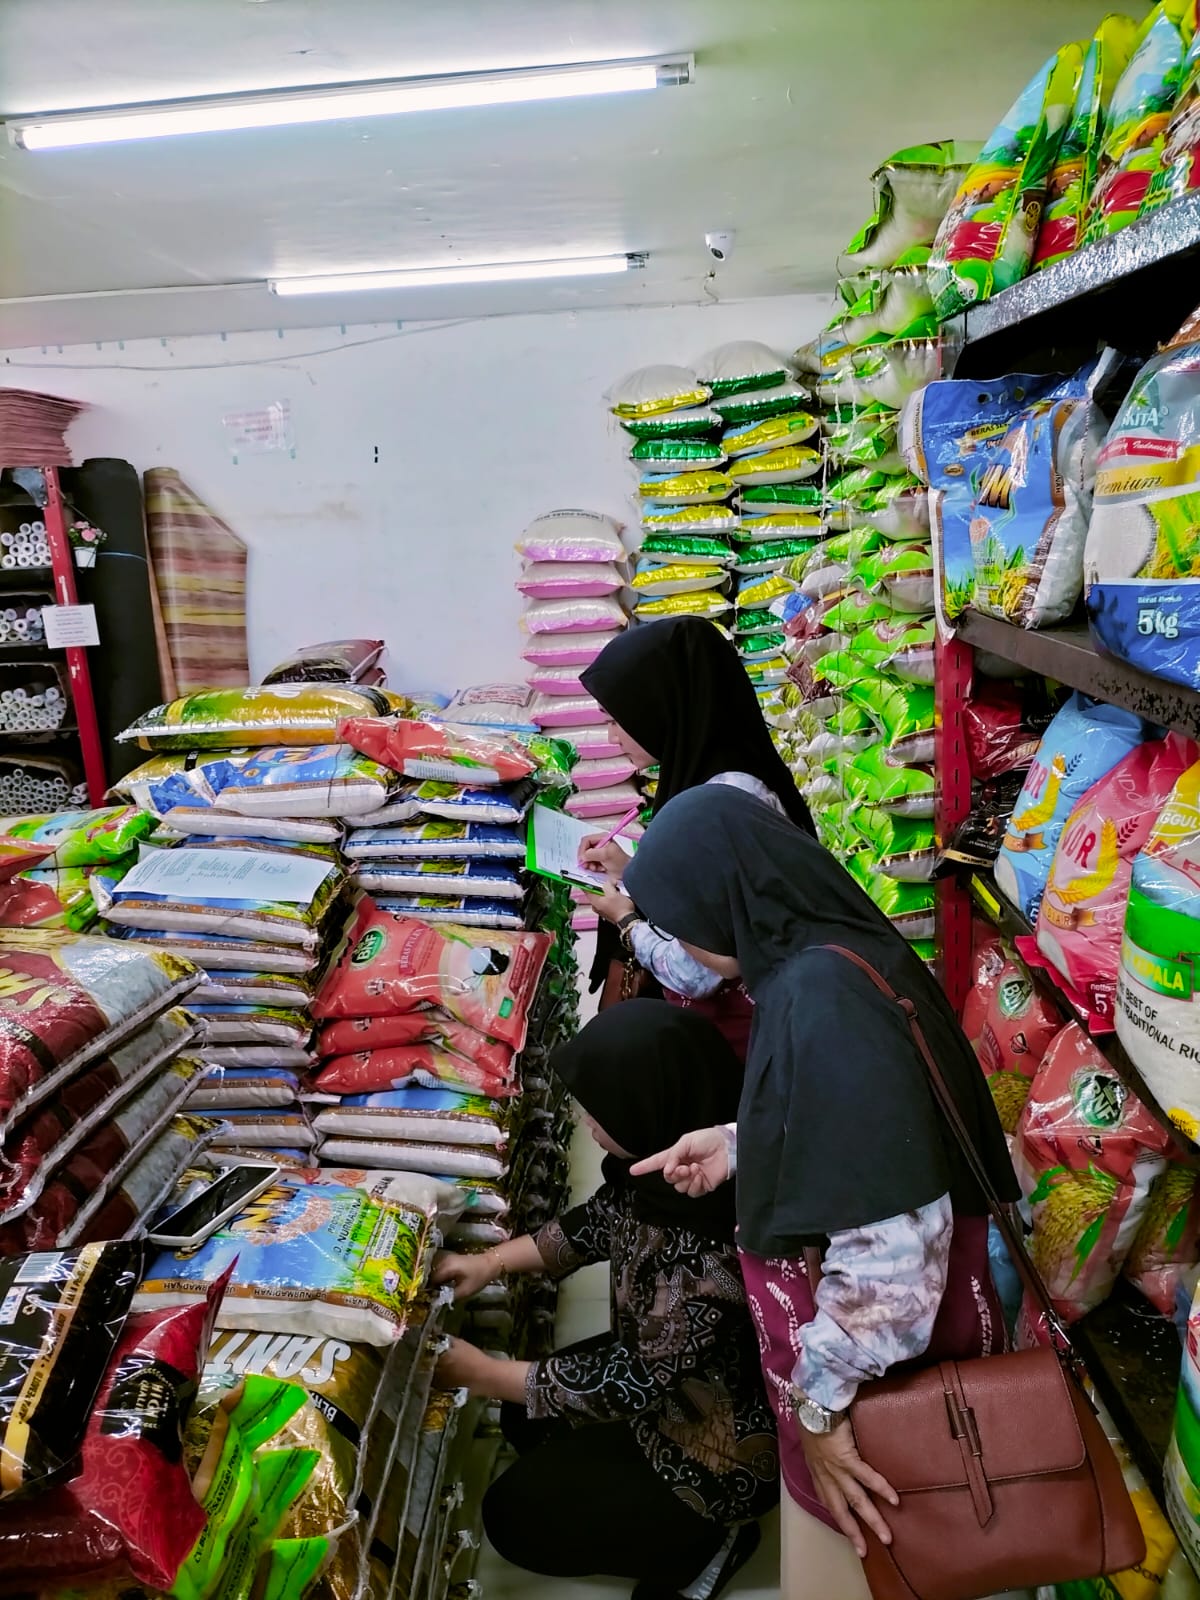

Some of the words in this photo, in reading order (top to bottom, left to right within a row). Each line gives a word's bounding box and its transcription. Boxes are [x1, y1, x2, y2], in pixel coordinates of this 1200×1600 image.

[970, 425, 995, 436] BERAS
[1137, 608, 1179, 639] 5kg
[356, 933, 378, 961] BNF
[1094, 993, 1108, 1014] 5
[1125, 987, 1144, 1012] BEST
[1144, 1005, 1158, 1021] OF
[1124, 1001, 1176, 1052] TRADITIONAL
[254, 1286, 312, 1300] NURMADINAH
